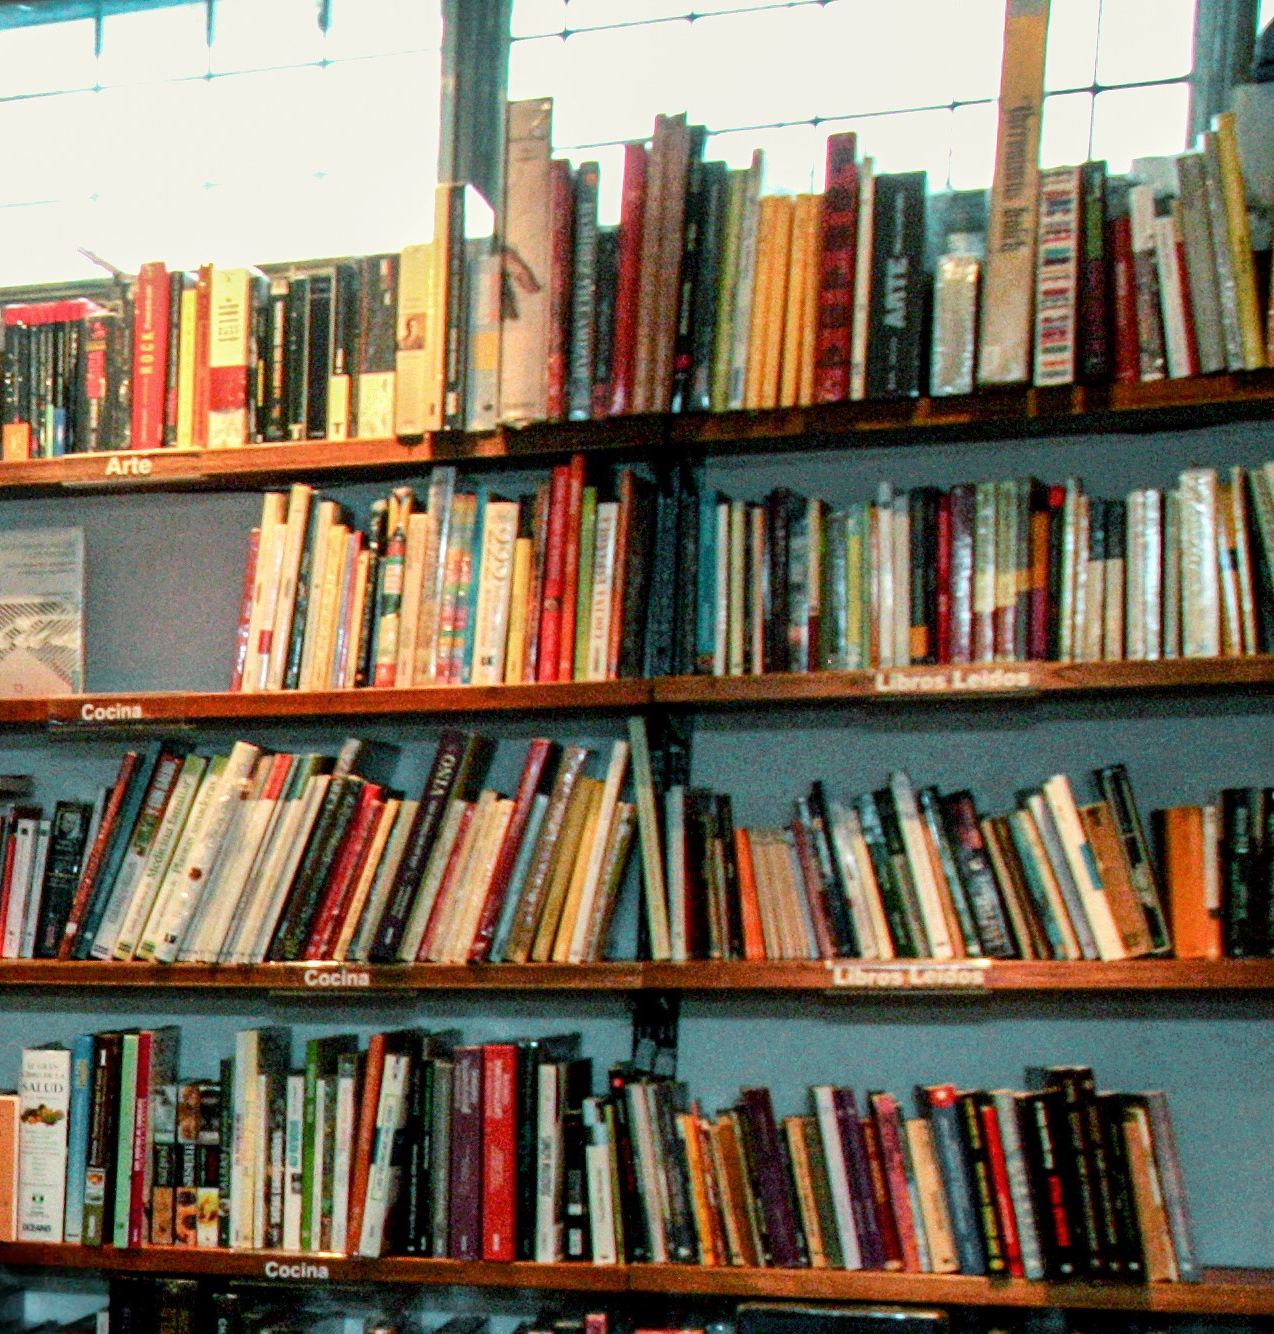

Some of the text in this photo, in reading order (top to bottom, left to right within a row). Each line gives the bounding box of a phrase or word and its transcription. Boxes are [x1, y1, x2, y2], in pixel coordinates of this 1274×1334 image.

[139, 328, 155, 375] ROCK
[105, 455, 152, 476] Arte
[875, 672, 946, 692] Libros
[81, 703, 143, 721] Cocina
[433, 752, 455, 798] VINO
[304, 969, 370, 987] Cocina
[834, 966, 906, 986] Libros
[20, 1082, 64, 1093] SALUD
[264, 1261, 330, 1280] Cocina
